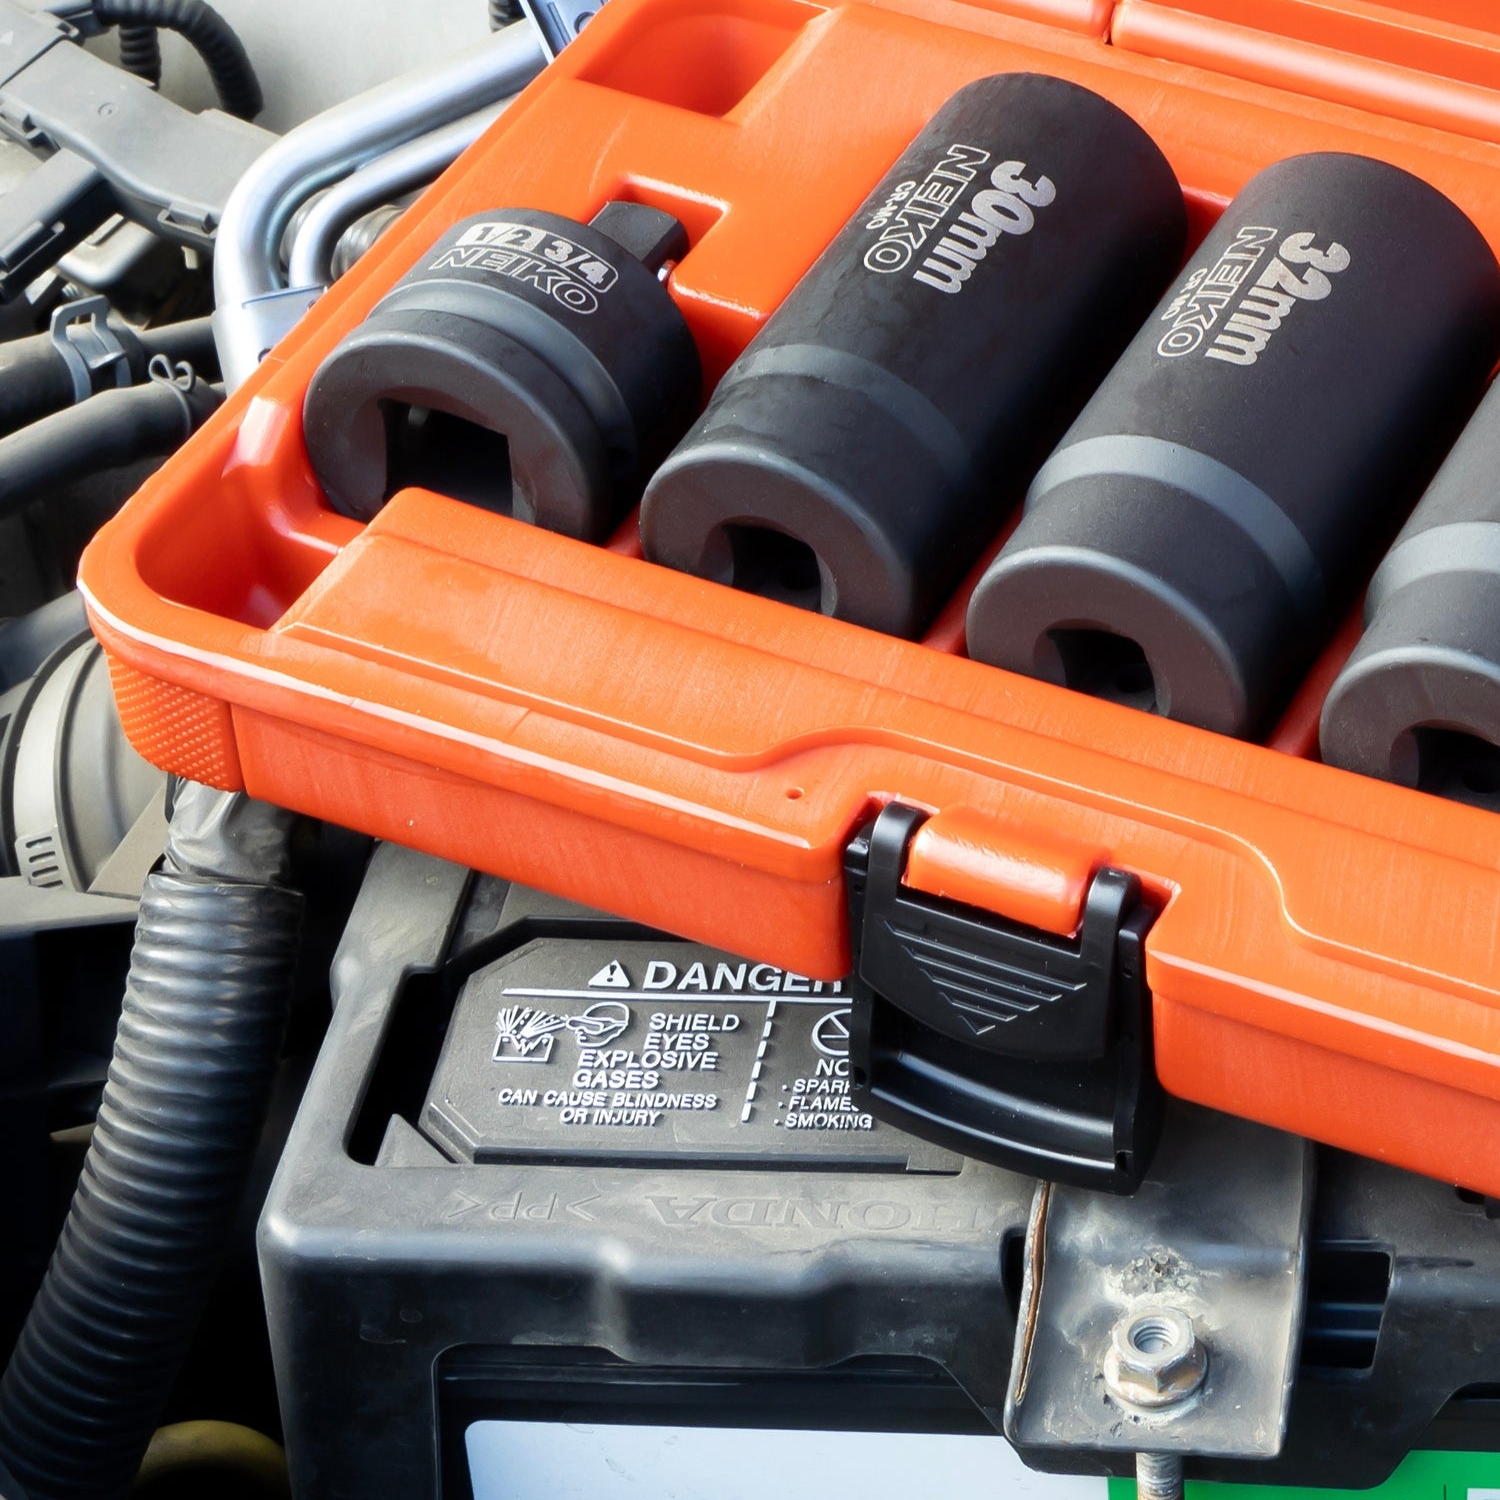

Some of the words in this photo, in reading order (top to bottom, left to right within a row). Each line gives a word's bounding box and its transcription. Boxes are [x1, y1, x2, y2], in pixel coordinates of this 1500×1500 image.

[864, 143, 991, 274] NEIKO
[912, 159, 1057, 294] 30mm
[471, 224, 535, 251] 1/2
[543, 239, 610, 286] 3/4
[428, 246, 599, 315] NEIKO
[1157, 226, 1279, 358] NEIKO
[1204, 231, 1351, 366] 32mm
[648, 1012, 740, 1032] SHIELD
[643, 1032, 710, 1052] EYES
[577, 1049, 719, 1071] EXPLOSIVE
[572, 1069, 660, 1090] GASES
[498, 1088, 537, 1106] CAN
[542, 1090, 607, 1108] CAUSE
[611, 1092, 718, 1110] BLINDNESS
[559, 1108, 589, 1125] OR
[592, 1109, 662, 1128] INJURY
[784, 1112, 874, 1130] SMOKING
[644, 1194, 988, 1233] HONDA
